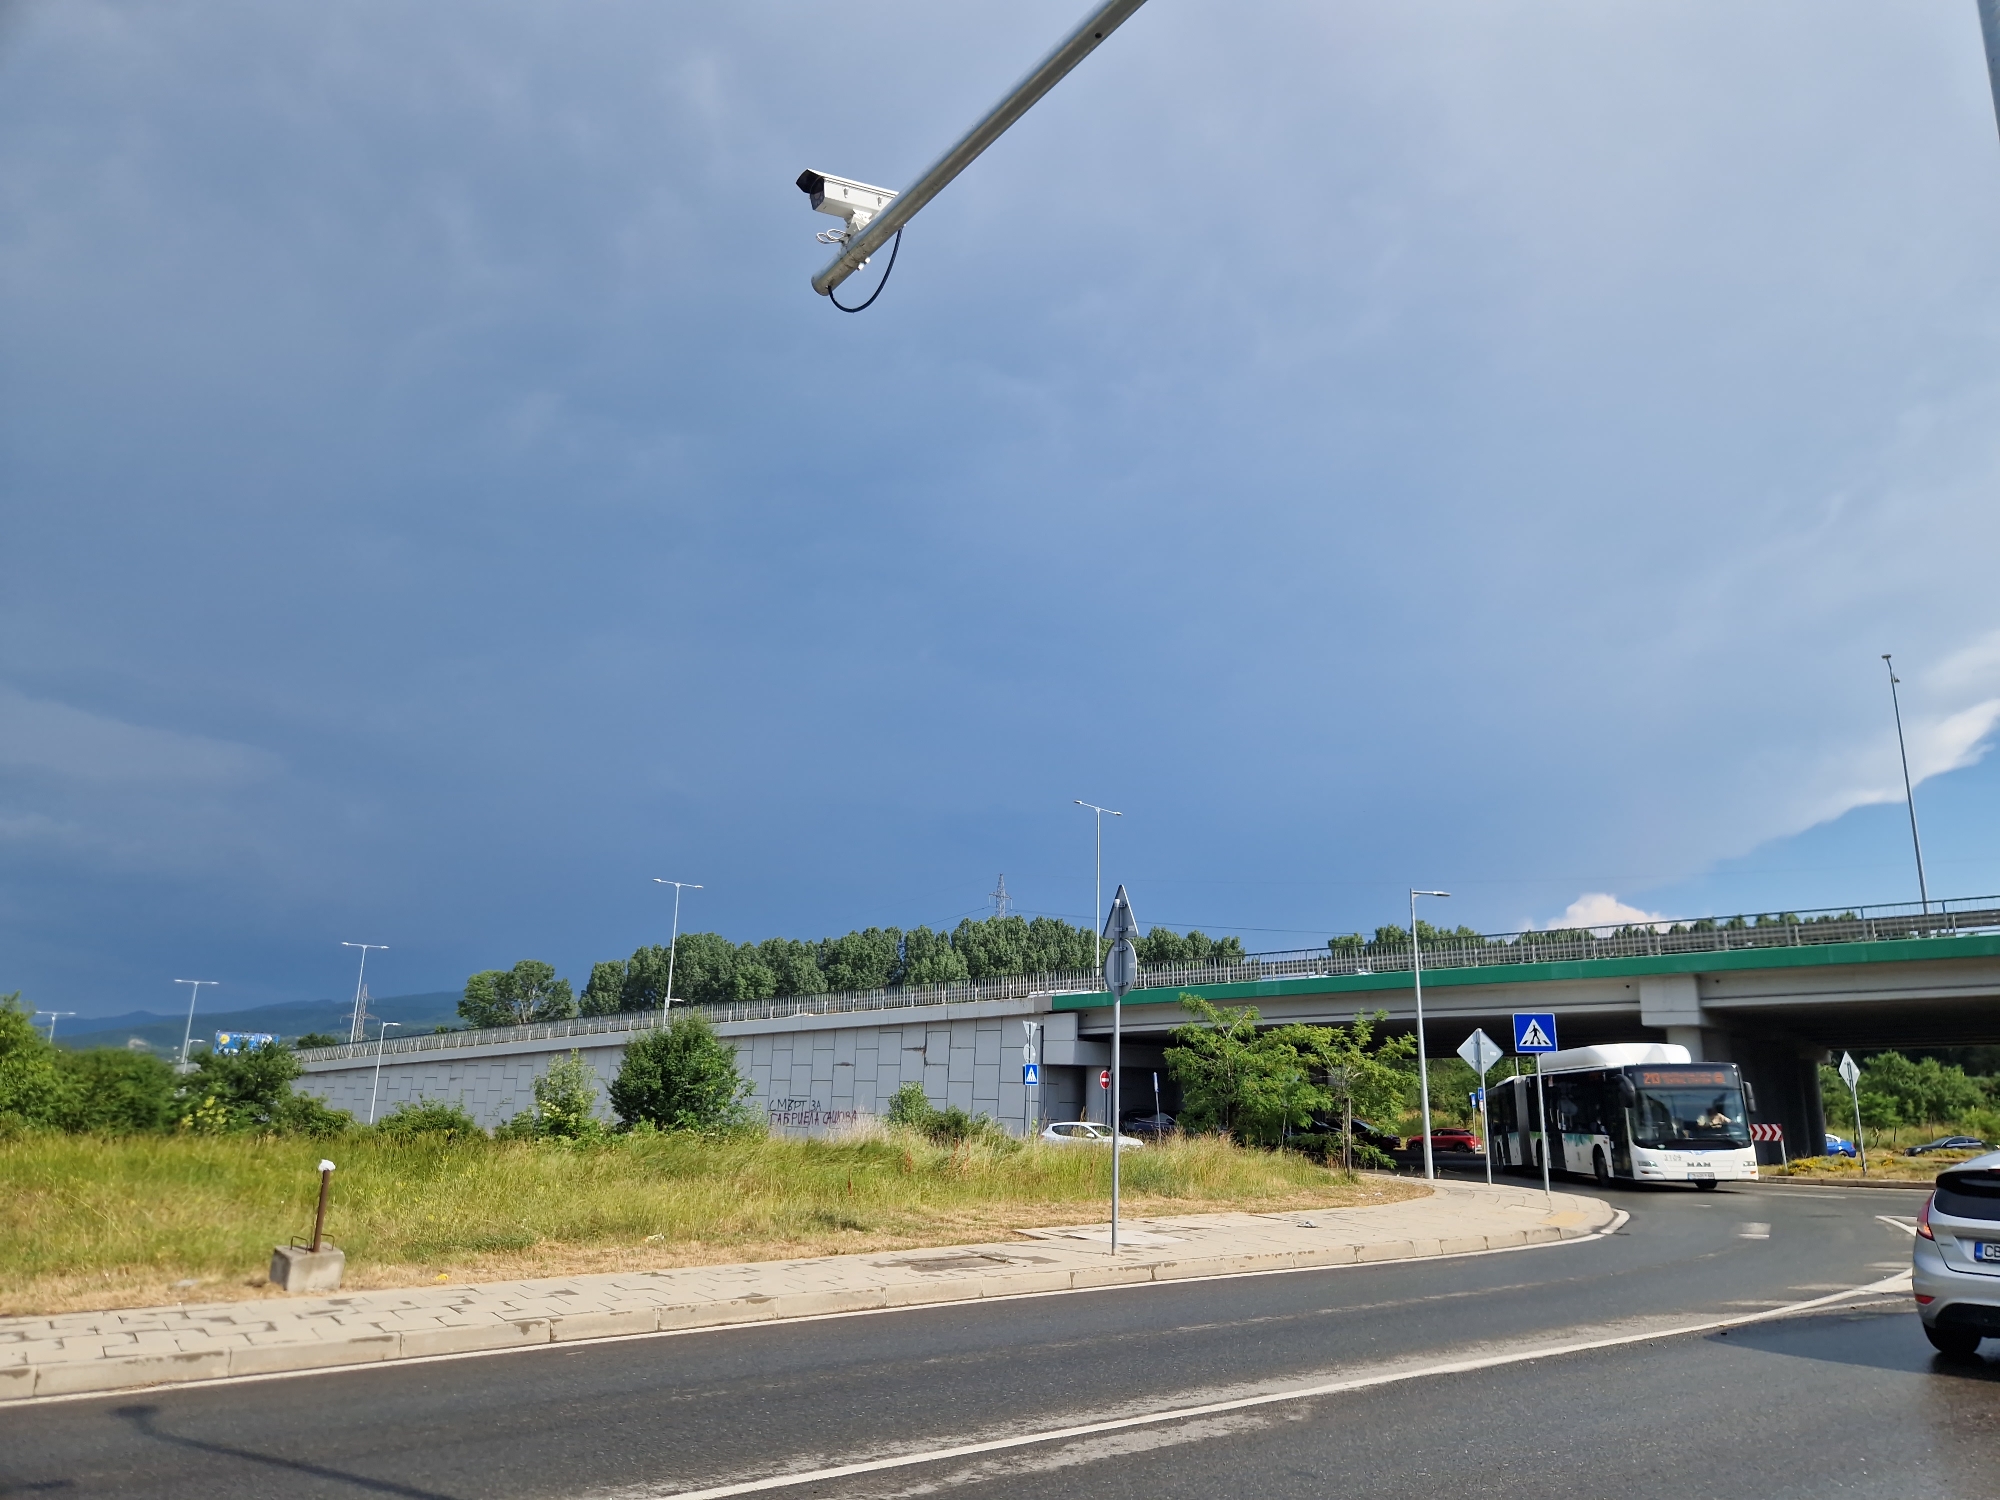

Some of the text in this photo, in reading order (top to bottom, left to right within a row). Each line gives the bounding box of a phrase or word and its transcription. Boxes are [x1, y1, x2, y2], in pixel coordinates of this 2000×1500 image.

[769, 1098, 822, 1112] СМЪРТ ЗА
[769, 1111, 820, 1126] ГАБРИЕЛА
